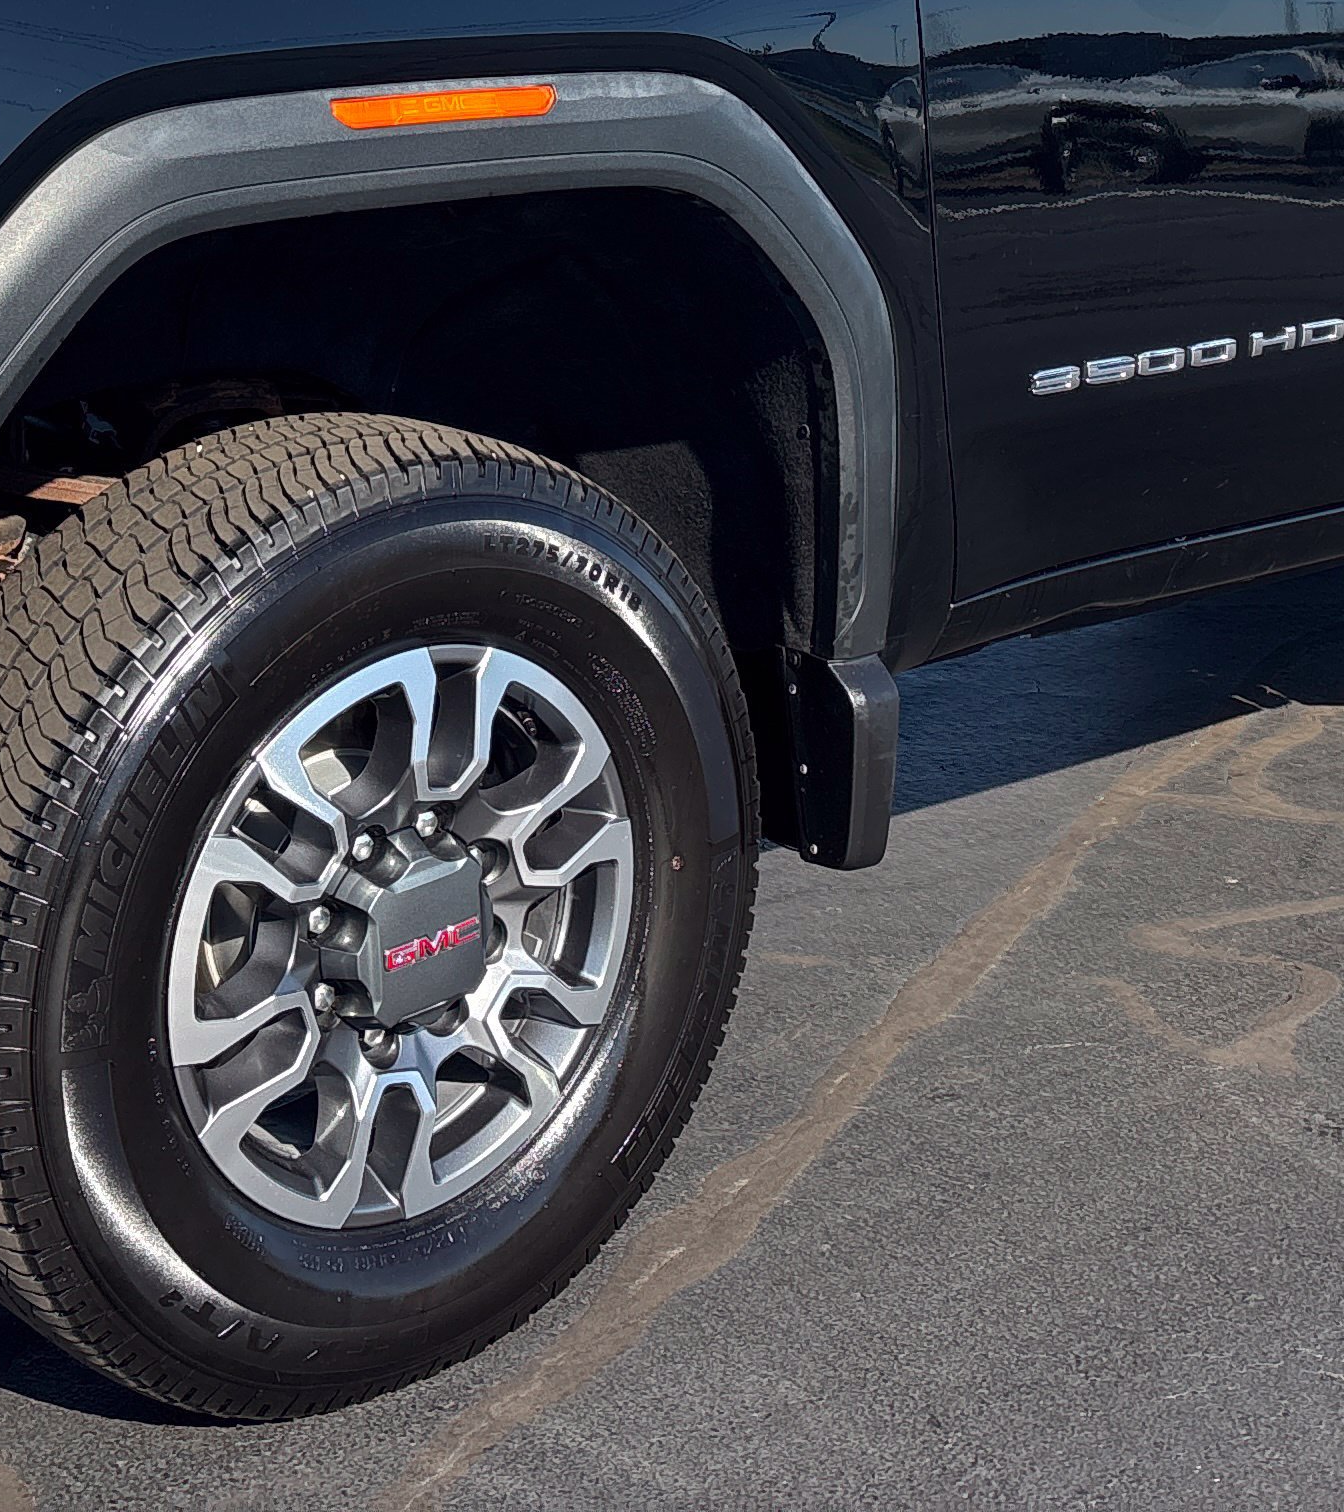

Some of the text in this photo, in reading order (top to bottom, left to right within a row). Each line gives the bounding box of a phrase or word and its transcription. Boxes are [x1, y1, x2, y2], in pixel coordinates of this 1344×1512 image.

[1028, 337, 1238, 396] 3500
[483, 532, 643, 612] LT275/70R18
[72, 666, 226, 967] MICHELIN
[384, 914, 480, 973] GMC
